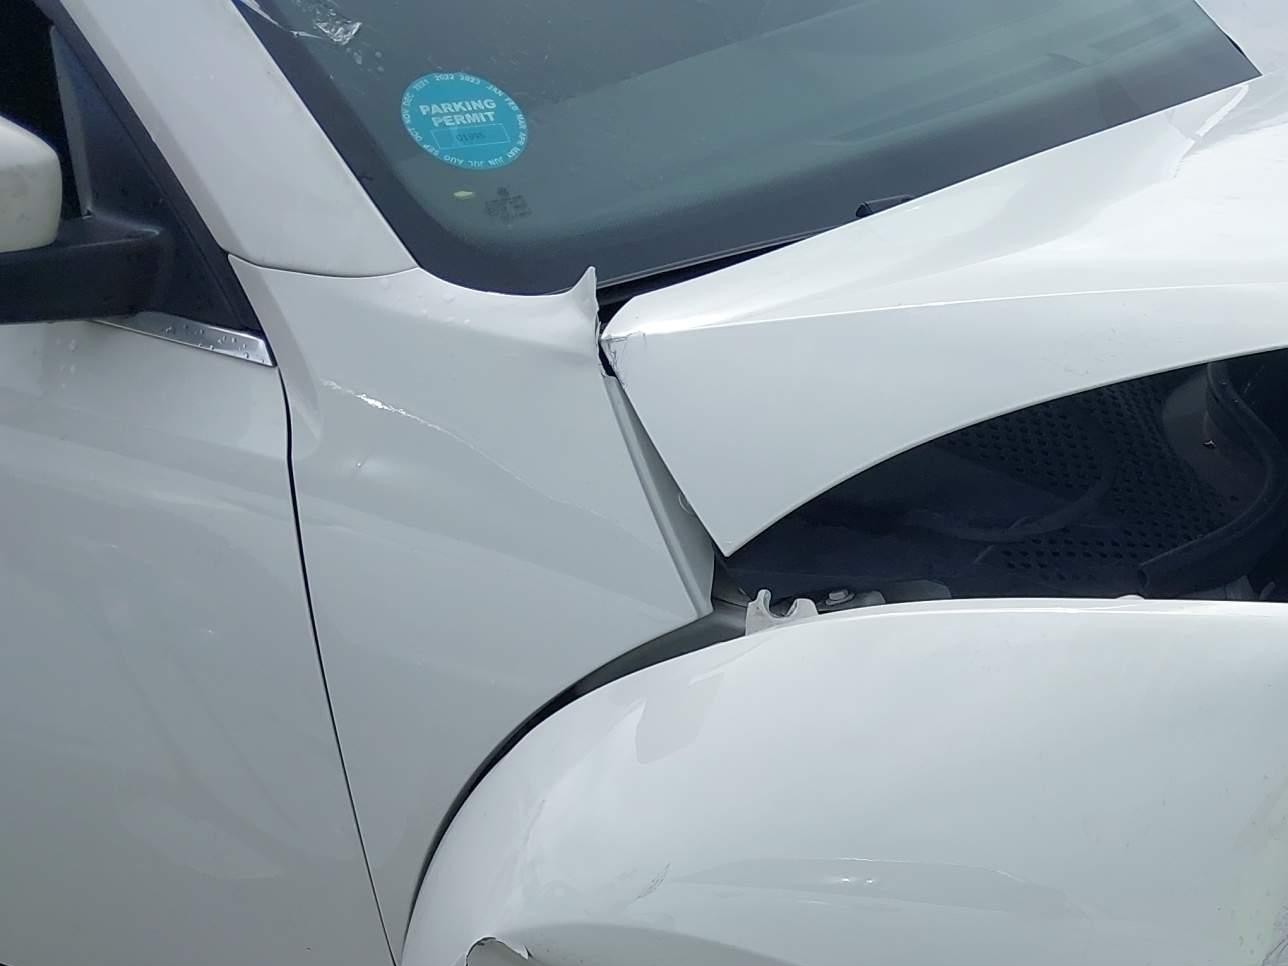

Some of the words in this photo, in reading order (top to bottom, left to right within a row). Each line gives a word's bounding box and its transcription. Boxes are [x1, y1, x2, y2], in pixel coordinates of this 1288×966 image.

[486, 84, 503, 97] JAN
[419, 98, 497, 116] PARKING
[431, 111, 496, 128] PERMIT
[487, 156, 505, 167] JUN
